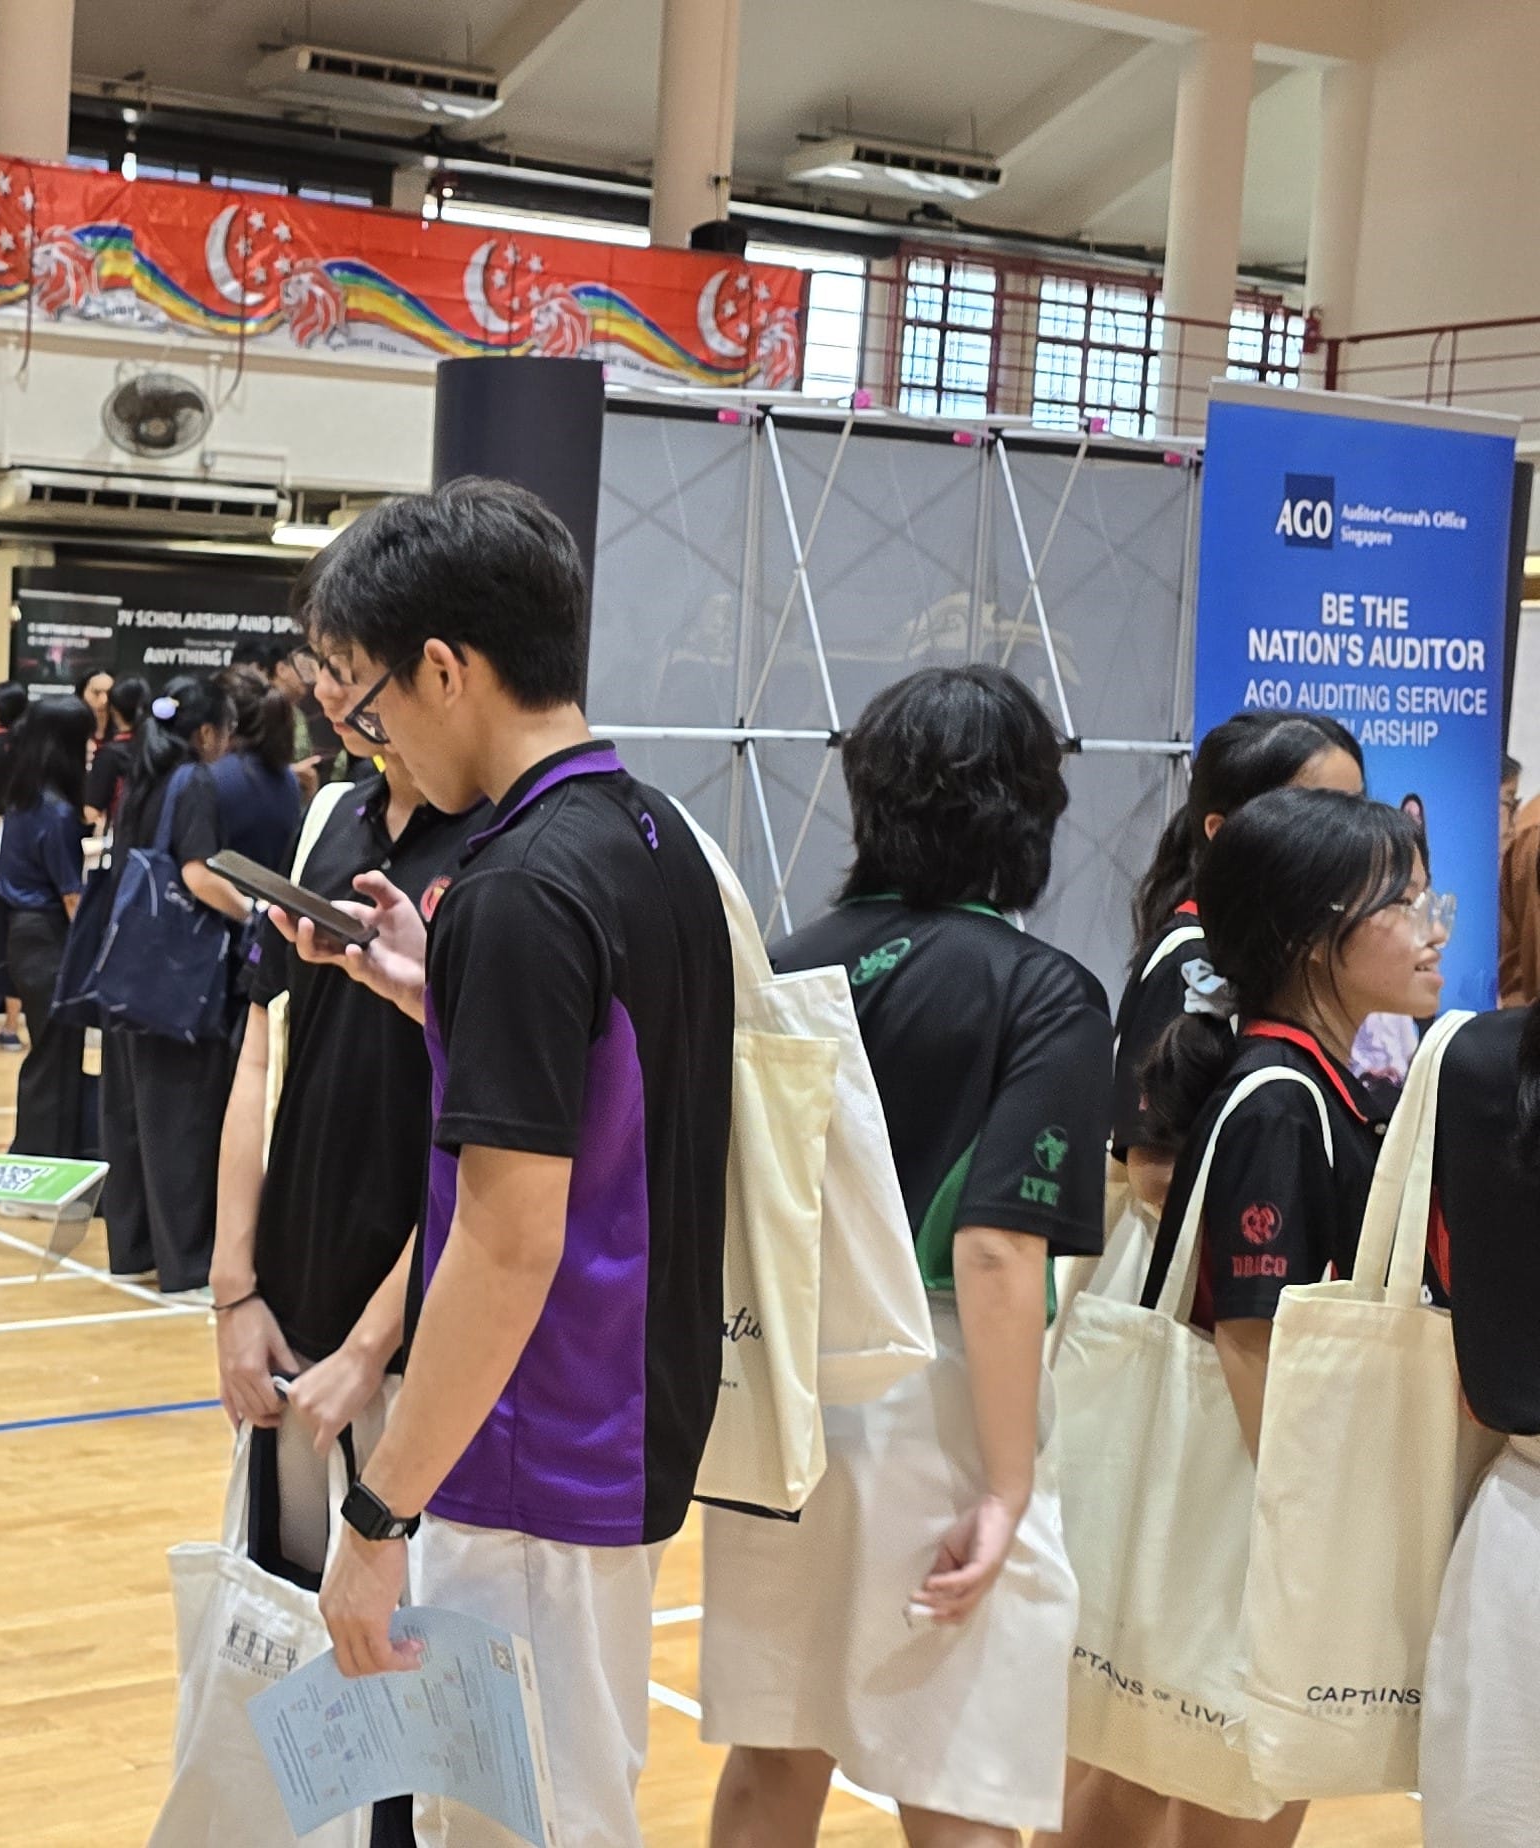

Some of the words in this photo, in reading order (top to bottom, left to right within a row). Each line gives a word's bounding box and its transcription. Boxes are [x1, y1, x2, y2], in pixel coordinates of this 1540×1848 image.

[1275, 498, 1333, 540] AGO
[1340, 525, 1393, 548] Singapore
[1432, 510, 1467, 531] Office
[135, 609, 239, 632] SCHOLARSHIP
[238, 614, 272, 633] AND
[1320, 591, 1355, 627] BE
[1360, 594, 1409, 630] THE
[1248, 627, 1365, 668] NATION'S
[1368, 636, 1485, 672] AUDITOR
[1243, 678, 1293, 709] AGO
[1296, 681, 1391, 713] AUDITING
[1396, 686, 1488, 716] SERVICE
